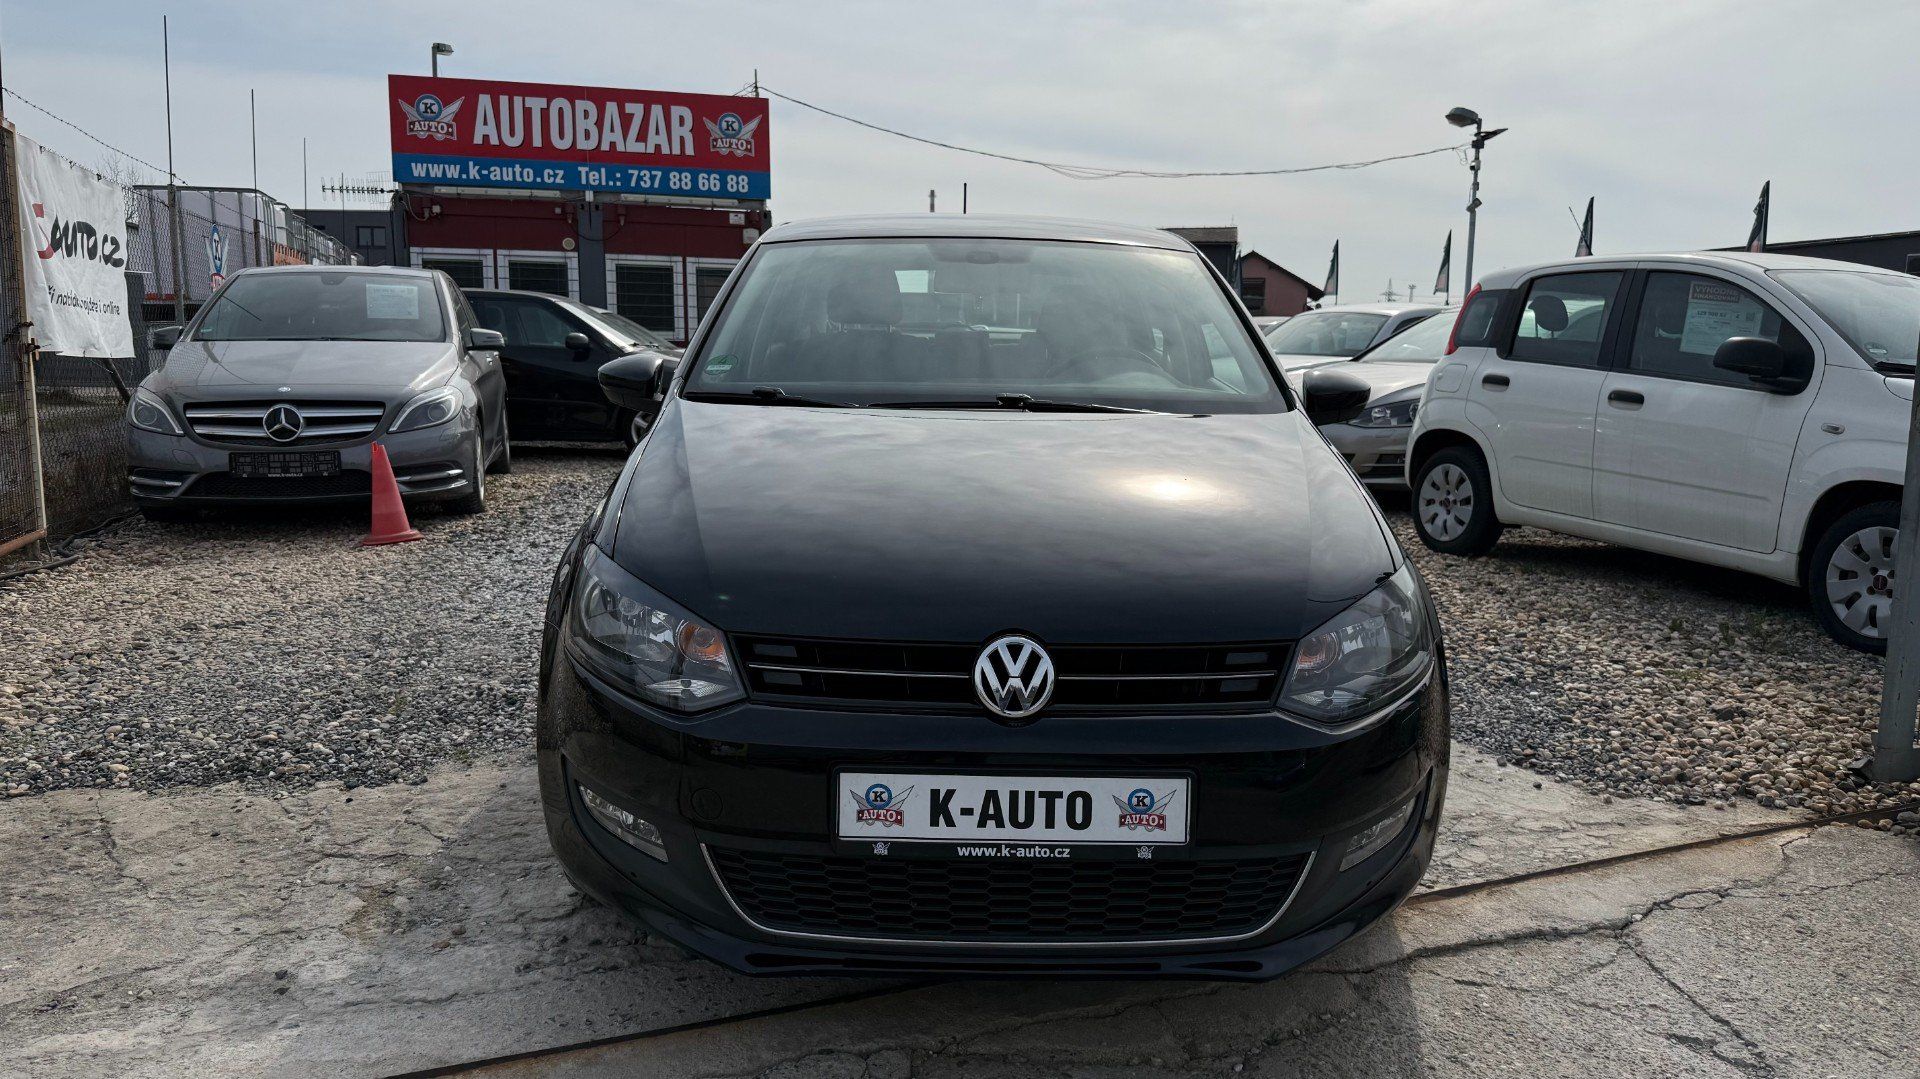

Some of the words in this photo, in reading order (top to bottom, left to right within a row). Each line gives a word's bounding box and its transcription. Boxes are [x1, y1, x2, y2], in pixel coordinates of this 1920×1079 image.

[422, 102, 436, 114] K
[413, 121, 448, 134] AUTO
[473, 93, 695, 156] AUTOBAZAR
[724, 120, 736, 131] K
[716, 138, 747, 151] AUTO
[411, 161, 565, 184] www.k-auto.cz
[577, 166, 622, 187] Tel.:
[628, 169, 660, 188] 737
[669, 171, 692, 189] 88
[698, 172, 720, 191] 66
[727, 174, 749, 193] 88
[872, 791, 886, 801] K
[1134, 795, 1148, 807] K
[929, 788, 1093, 831] K-AUTO
[862, 810, 895, 822] AUTO
[1124, 815, 1159, 827] AUTO
[957, 845, 1071, 858] www.k-auto.cz
